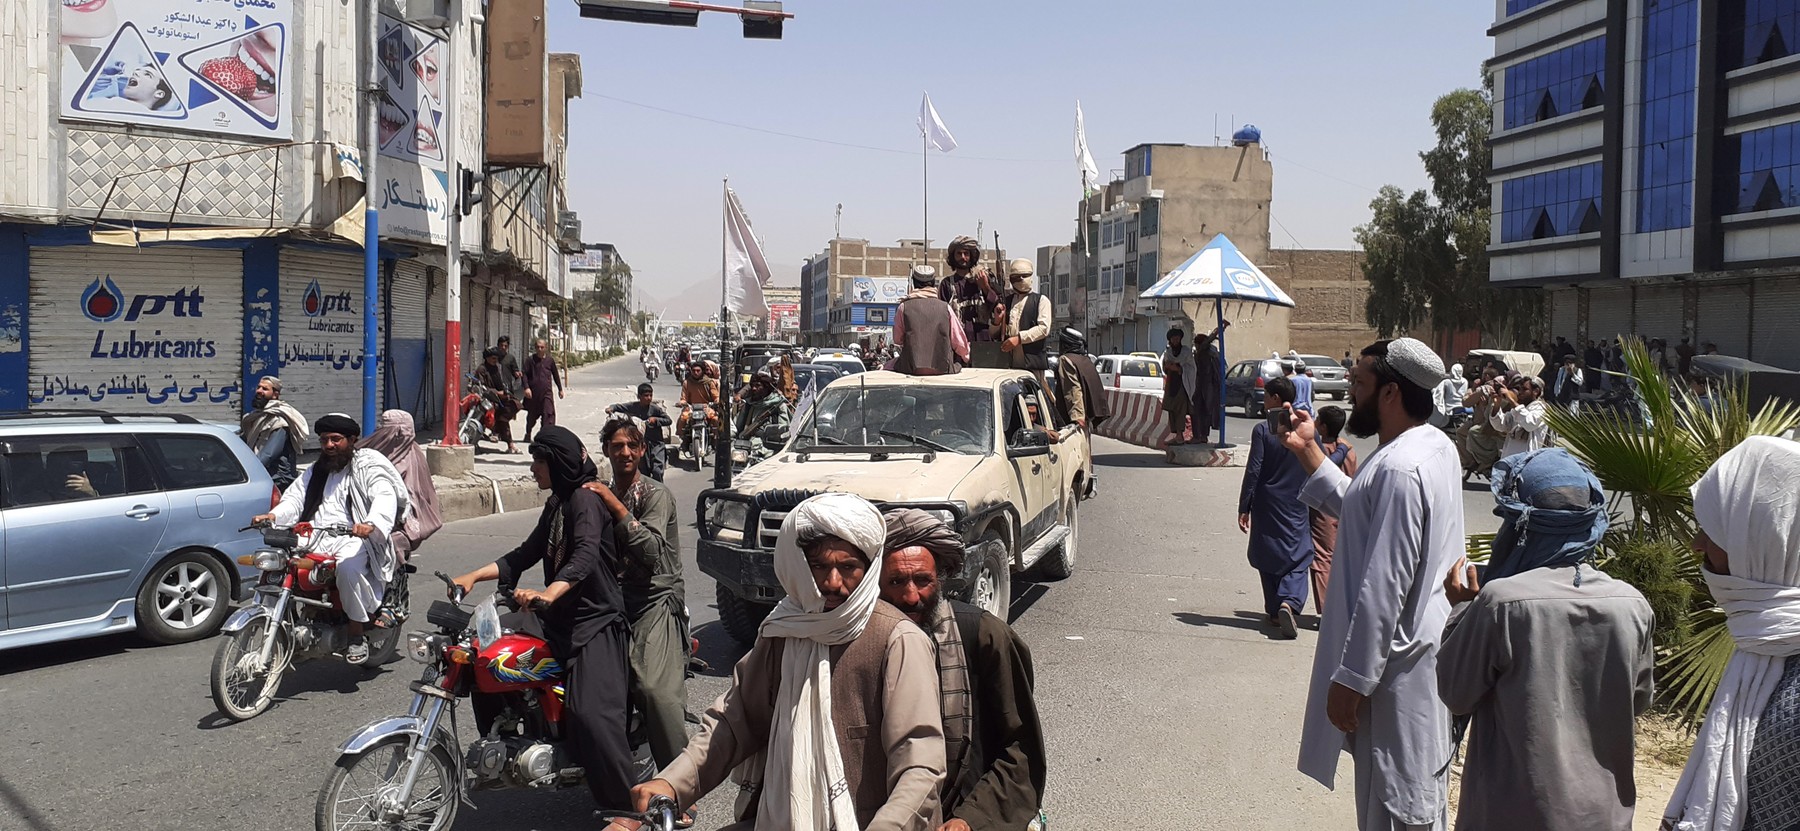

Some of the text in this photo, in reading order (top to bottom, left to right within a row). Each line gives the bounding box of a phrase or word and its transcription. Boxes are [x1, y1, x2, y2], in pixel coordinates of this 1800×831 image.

[381, 178, 447, 220] رستگار
[124, 285, 205, 322] ptt
[321, 289, 352, 316] ptt
[308, 317, 355, 333] Lubricants
[90, 329, 216, 359] Lubricants
[146, 374, 179, 404] تی
[179, 374, 208, 403] تی
[208, 379, 239, 409] پی
